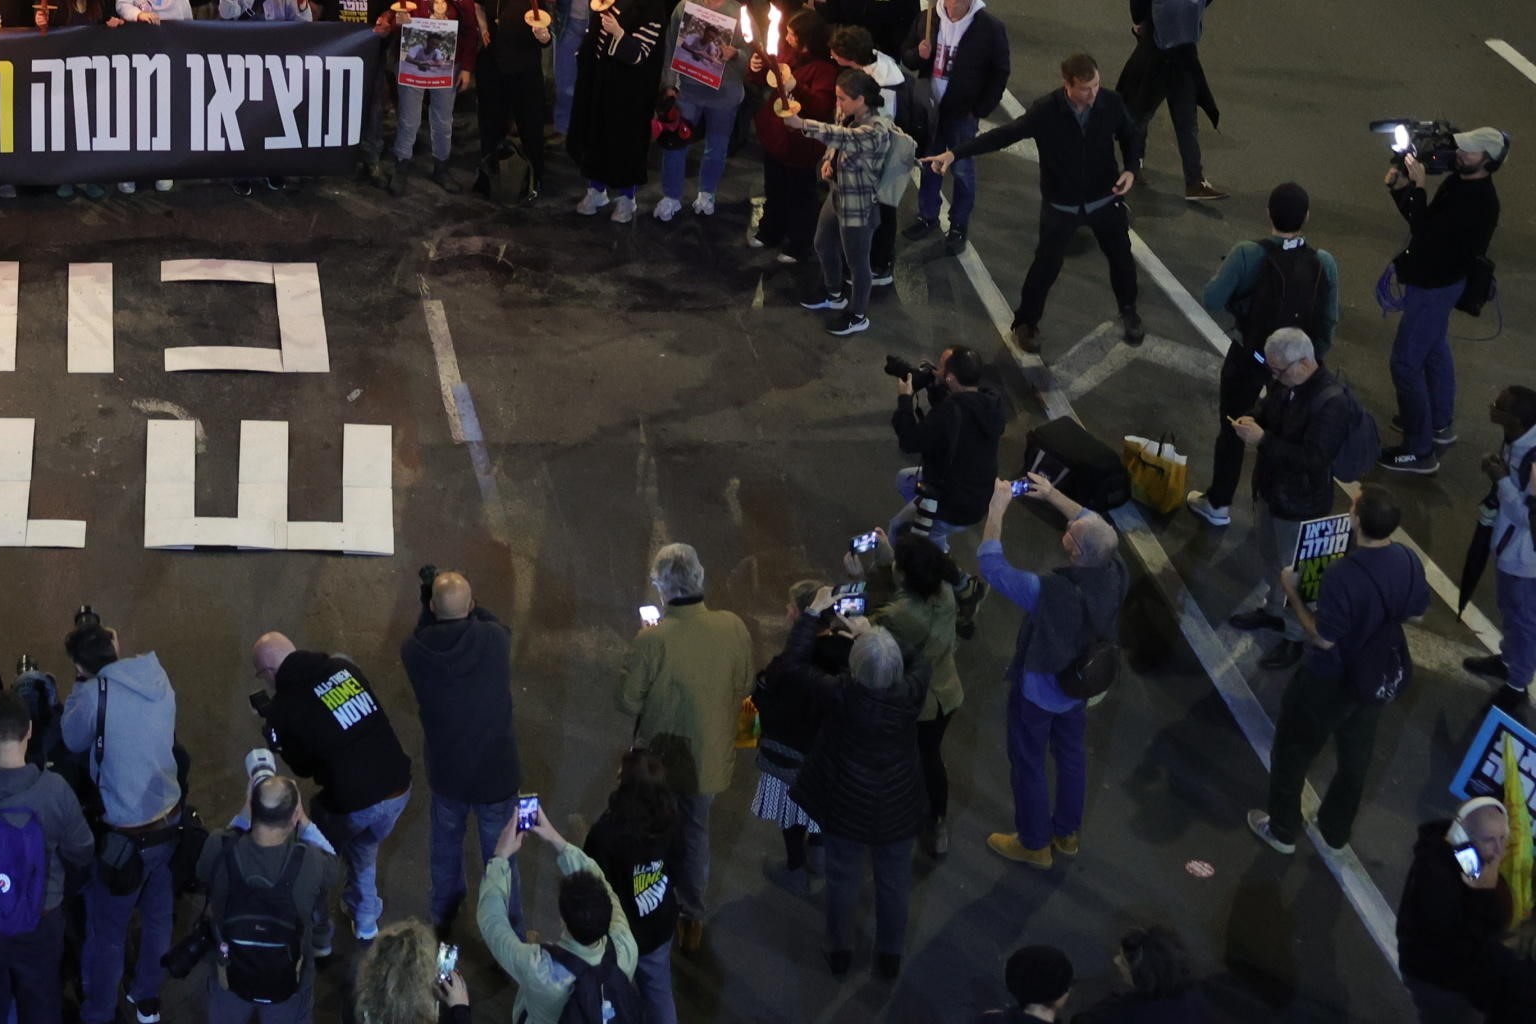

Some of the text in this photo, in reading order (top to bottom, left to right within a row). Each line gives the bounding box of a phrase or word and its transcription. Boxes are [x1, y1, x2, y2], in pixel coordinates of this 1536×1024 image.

[30, 54, 173, 152] מעזה
[186, 56, 363, 151] תוציאו
[1304, 516, 1352, 539] תוציאו
[1299, 533, 1350, 561] מעזה
[313, 668, 353, 697] ALL THEM
[320, 676, 365, 713] HOME!
[332, 692, 378, 731] NOW!
